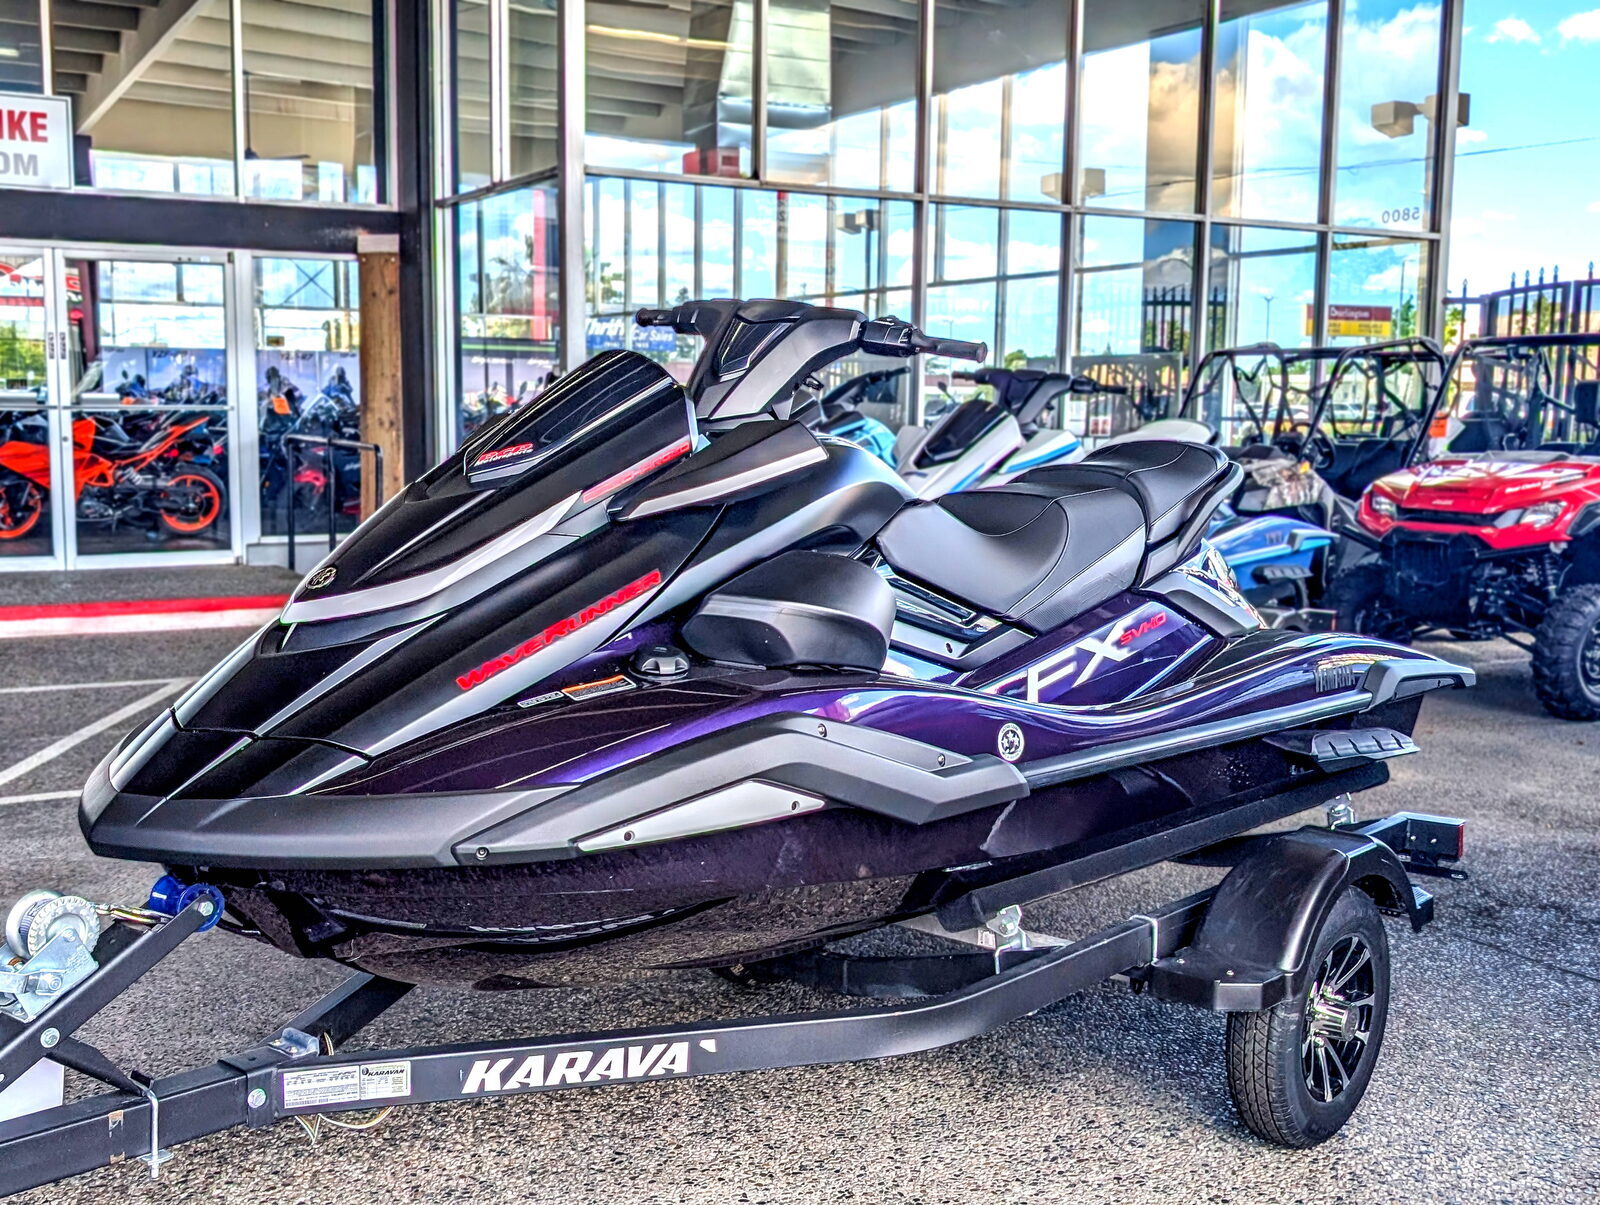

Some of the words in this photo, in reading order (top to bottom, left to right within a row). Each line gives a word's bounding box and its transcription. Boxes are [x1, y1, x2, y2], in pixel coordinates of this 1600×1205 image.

[582, 440, 691, 504] CHARGED
[1027, 604, 1141, 703] FX
[1119, 611, 1168, 646] SVHO
[367, 1068, 405, 1077] KARAVAN
[461, 1038, 717, 1094] KARAVA
